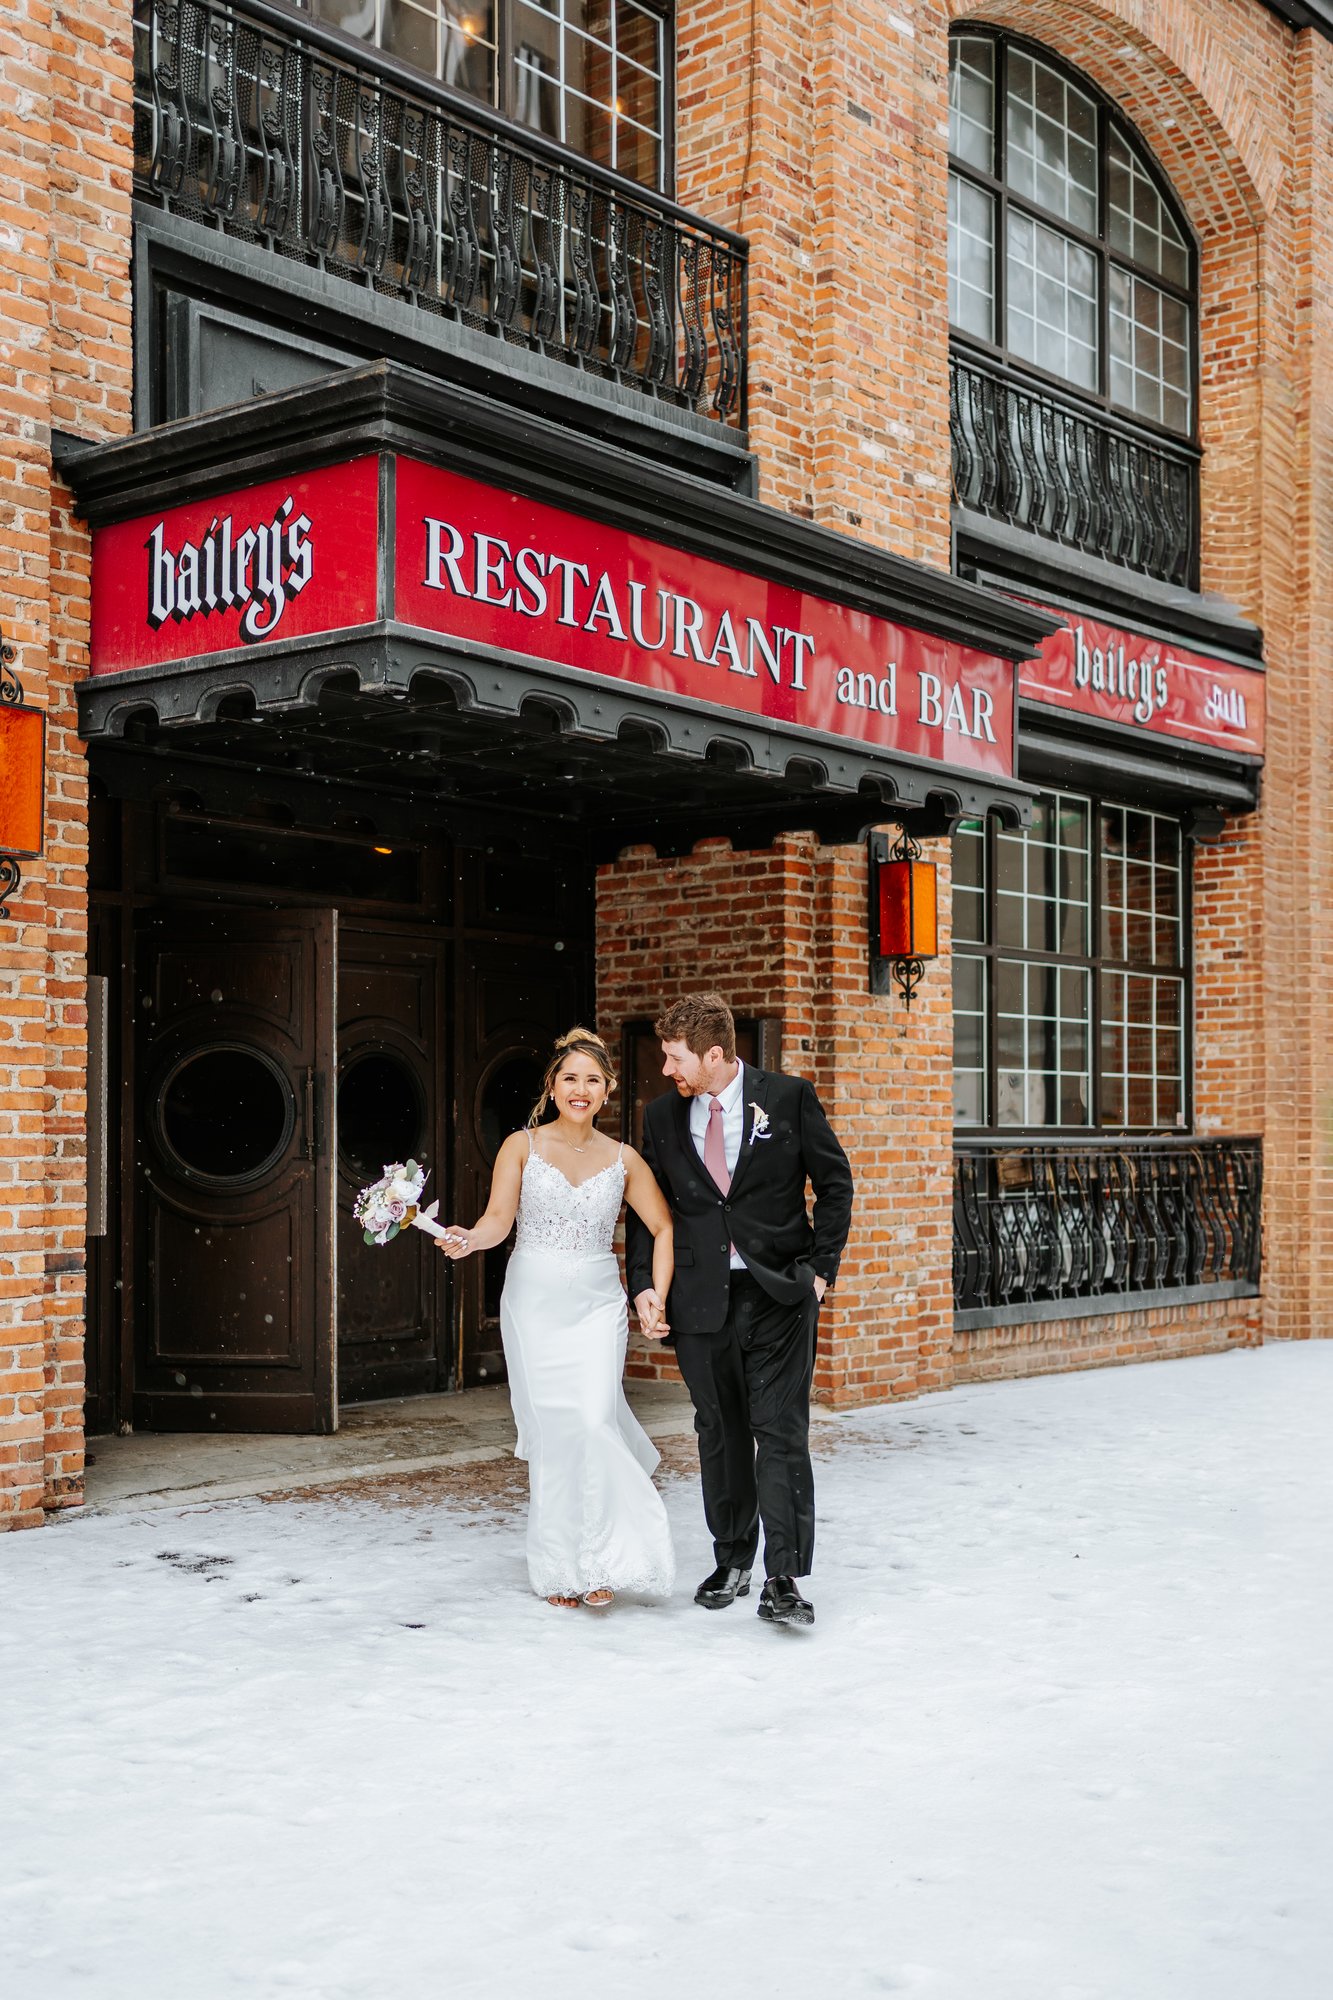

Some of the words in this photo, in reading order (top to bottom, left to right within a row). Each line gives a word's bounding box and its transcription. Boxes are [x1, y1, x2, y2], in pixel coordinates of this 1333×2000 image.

[147, 495, 313, 643] bailey's
[421, 516, 815, 690] RESTAURANT
[837, 662, 897, 716] and
[917, 671, 997, 743] BAR
[1074, 625, 1168, 724] bailey's
